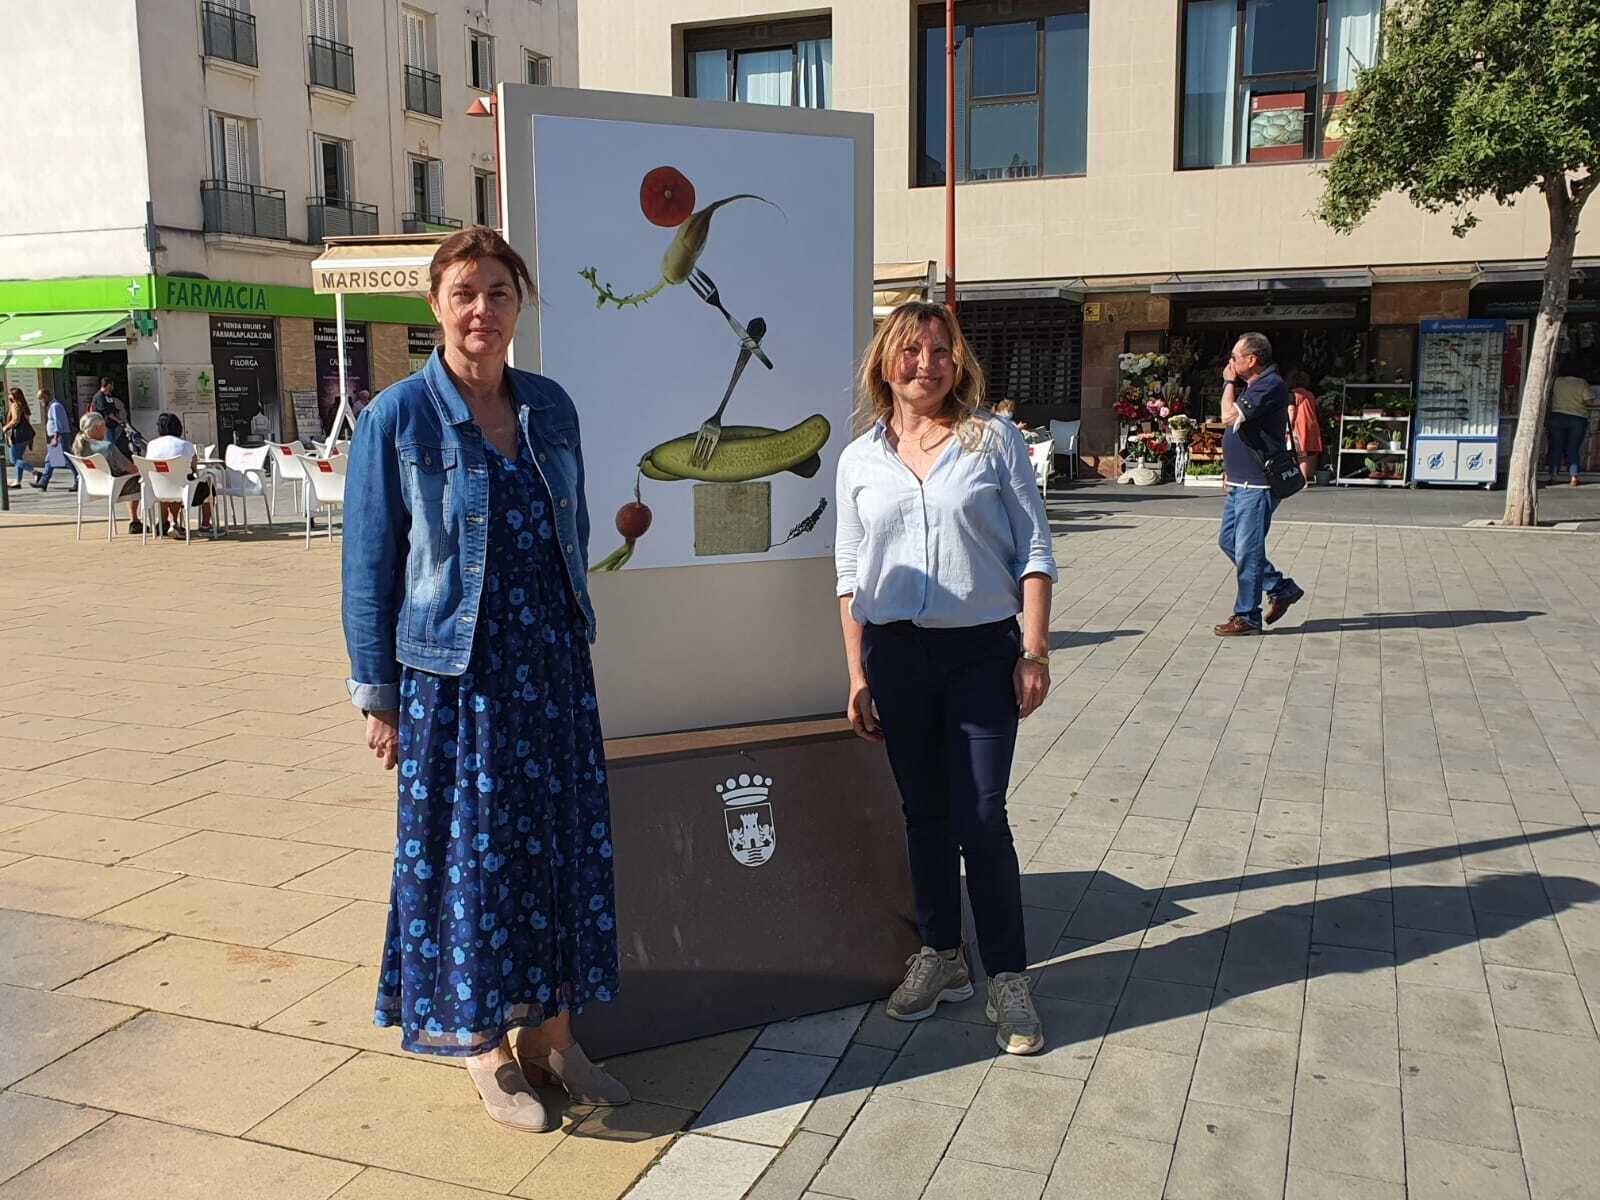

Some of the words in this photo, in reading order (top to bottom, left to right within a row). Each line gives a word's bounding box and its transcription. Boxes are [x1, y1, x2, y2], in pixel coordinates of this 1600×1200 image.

[321, 270, 419, 288] MARISCOS
[167, 280, 267, 311] FARMACIA
[230, 359, 259, 367] FILORGA
